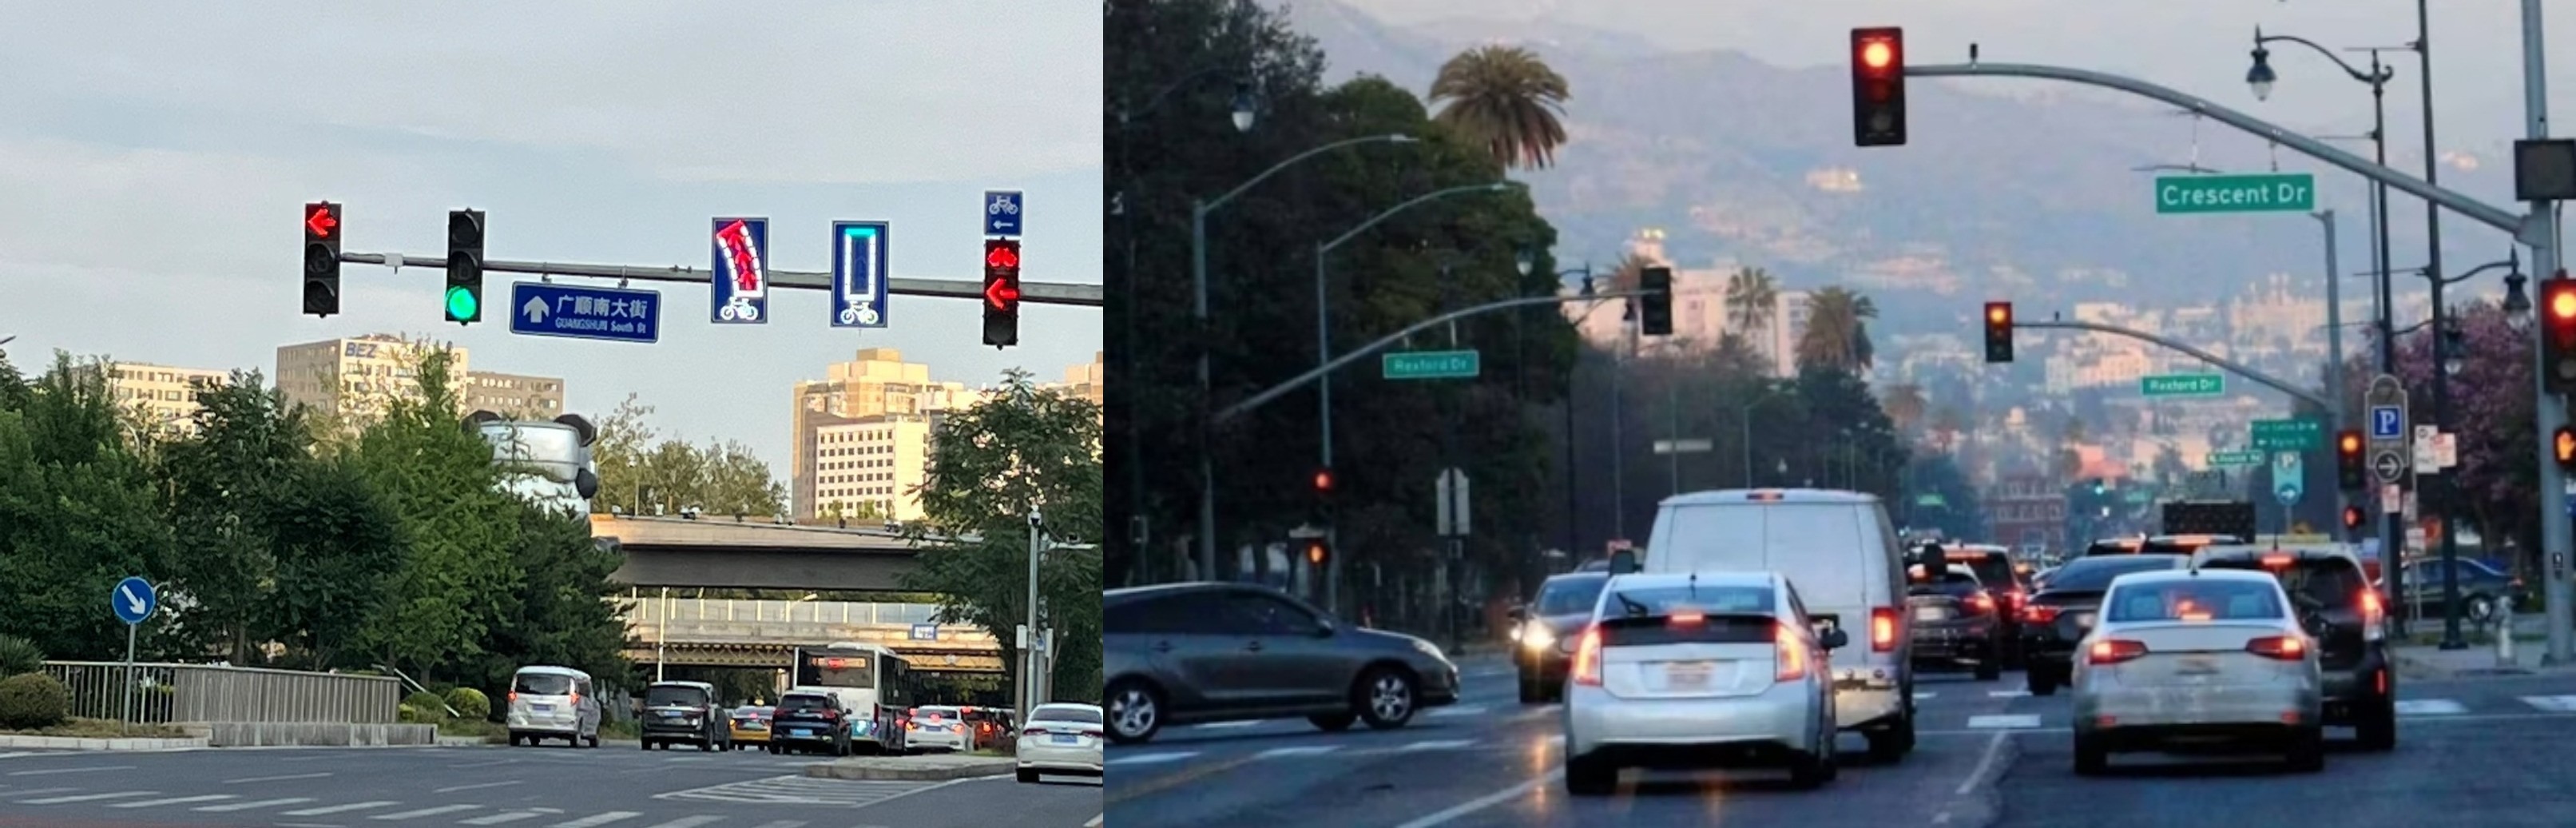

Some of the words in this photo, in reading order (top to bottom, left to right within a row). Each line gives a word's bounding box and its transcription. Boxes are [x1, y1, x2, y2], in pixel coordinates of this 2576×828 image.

[2162, 184, 2270, 205] Crescent
[2277, 182, 2307, 203] Dr
[556, 294, 648, 319] 广顺南大街
[610, 320, 634, 332] South
[2379, 409, 2396, 434] P
